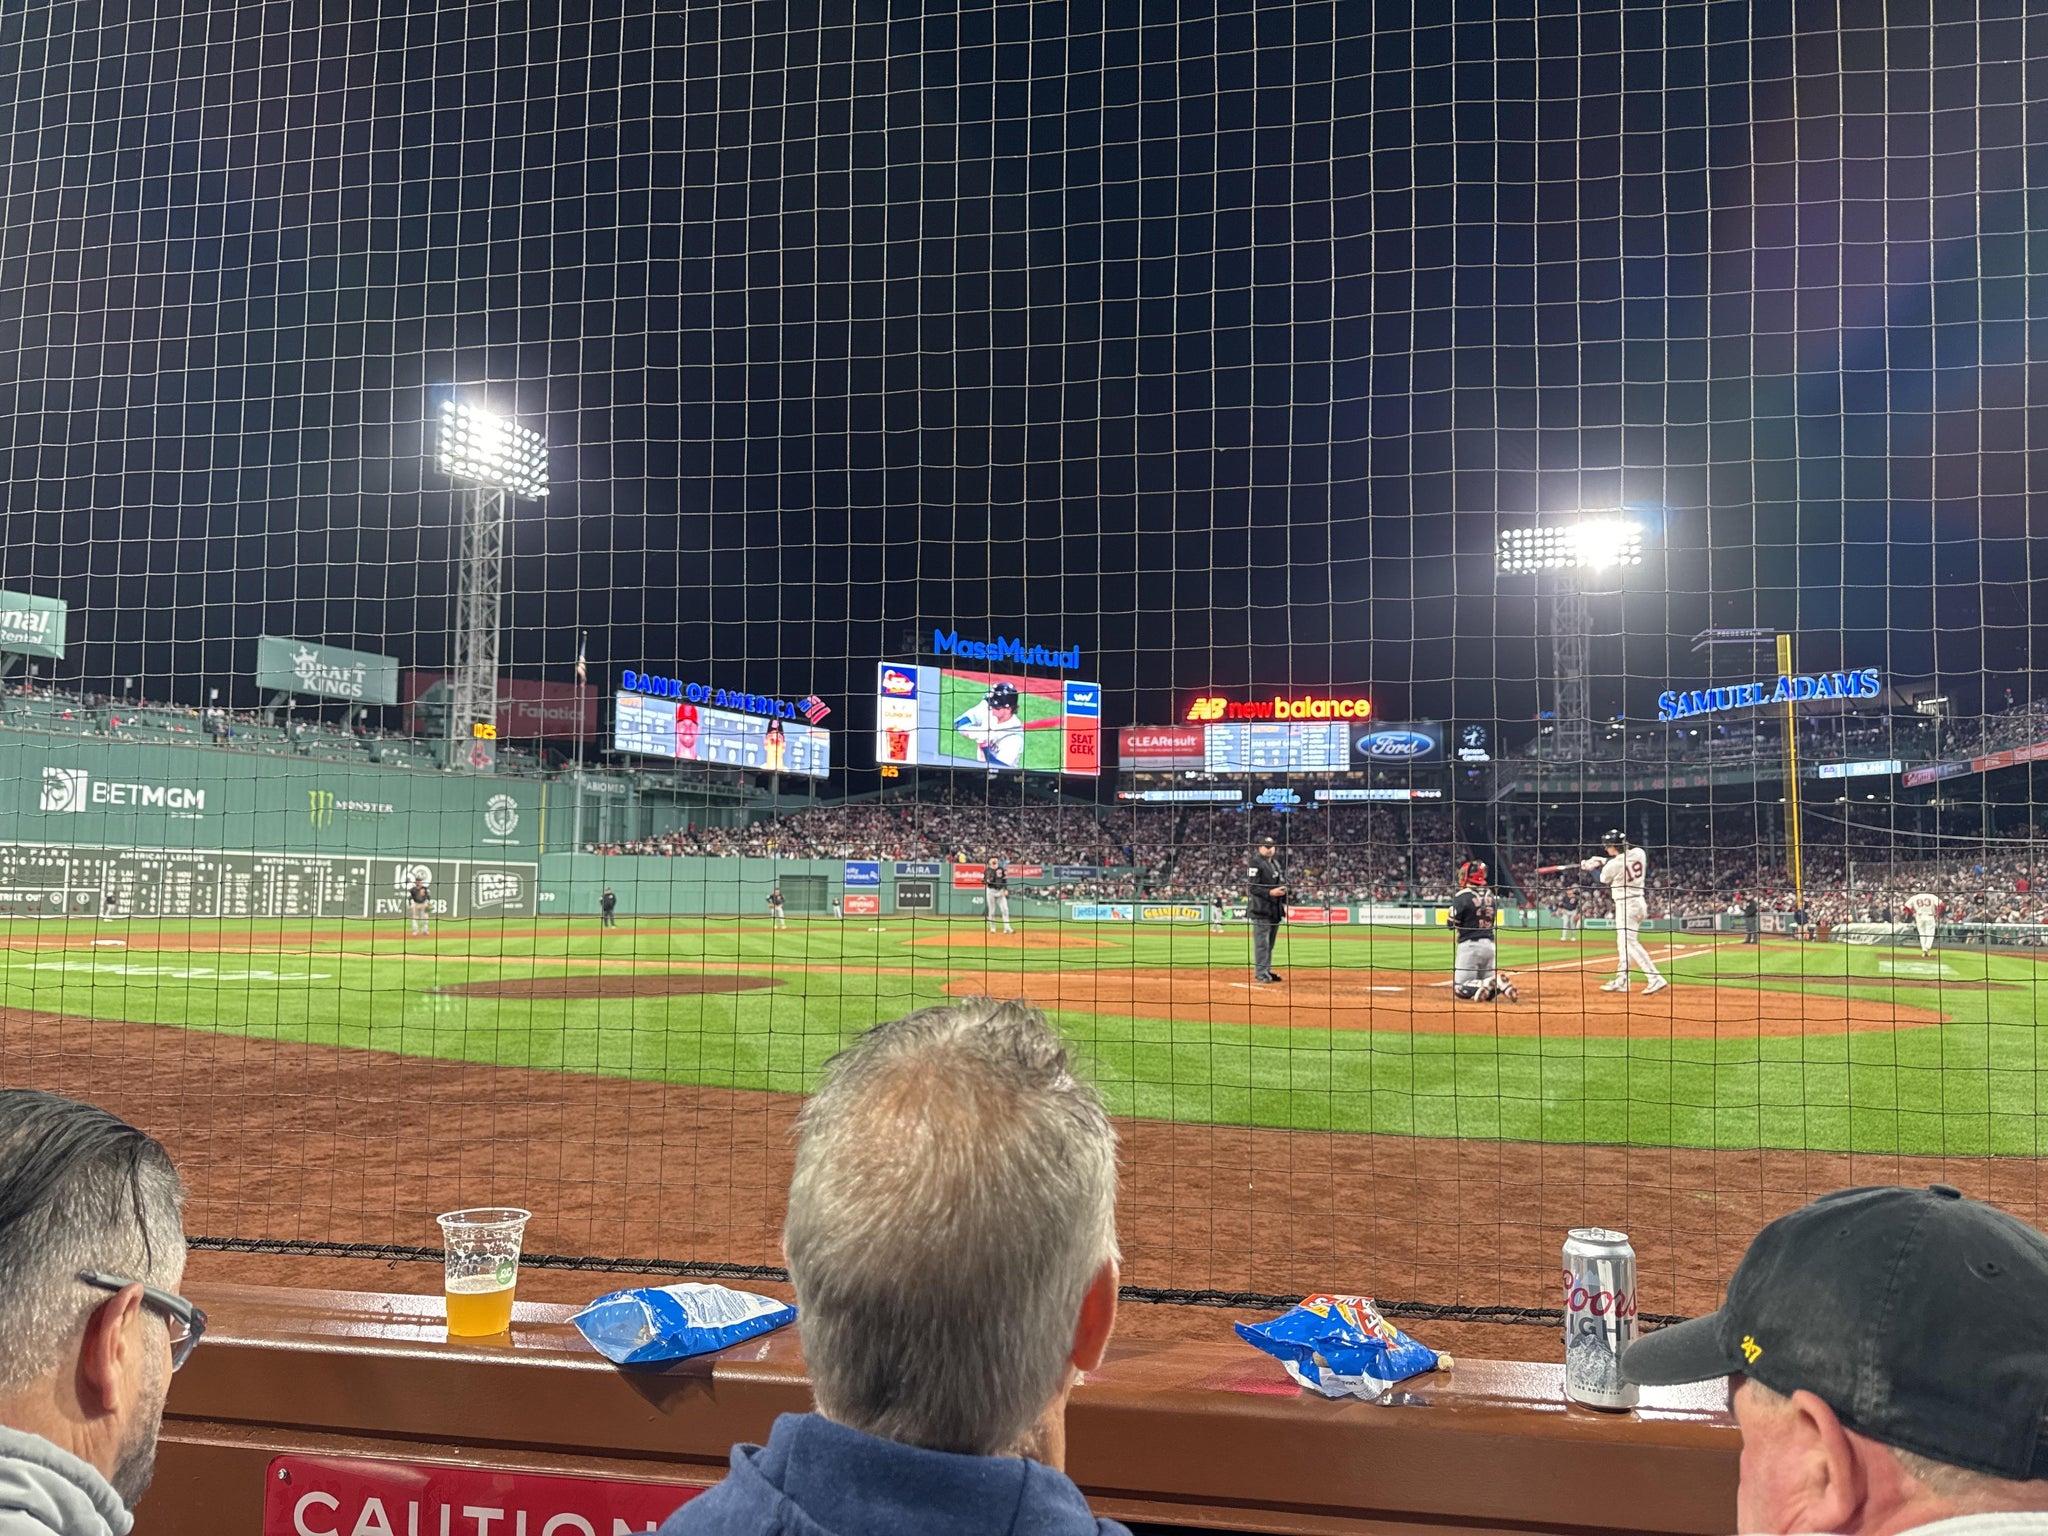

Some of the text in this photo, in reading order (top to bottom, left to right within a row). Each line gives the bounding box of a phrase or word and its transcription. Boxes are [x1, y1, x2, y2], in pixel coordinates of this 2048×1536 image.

[0, 610, 51, 633] nal.
[933, 628, 1080, 669] MassMutual
[294, 662, 366, 683] DRAFT
[303, 677, 363, 697] KINGS
[623, 669, 796, 720] BANK OF AMERICA
[1658, 668, 1881, 722] SAMUEL ADAMS
[518, 702, 586, 721] Fanatics
[1229, 702, 1273, 718] new
[1275, 696, 1370, 718] balance
[1071, 733, 1094, 745] SEAT
[1127, 735, 1197, 747] CLEAResult
[1371, 735, 1419, 754] Ford
[1070, 744, 1094, 756] GEEK
[92, 782, 205, 810] BETMGM
[586, 780, 626, 793] ABIOMED
[336, 800, 393, 813] MONSTER
[30, 849, 69, 857] PARK
[119, 852, 205, 862] AMERICAN LEAGUE
[482, 873, 518, 889] ACE
[1625, 860, 1643, 883] 19
[25, 893, 45, 902] OUT
[483, 888, 518, 900] TICKET
[375, 898, 403, 913] F.W.
[1569, 1314, 1633, 1341] IGHT
[292, 1490, 657, 1536] CAUT
